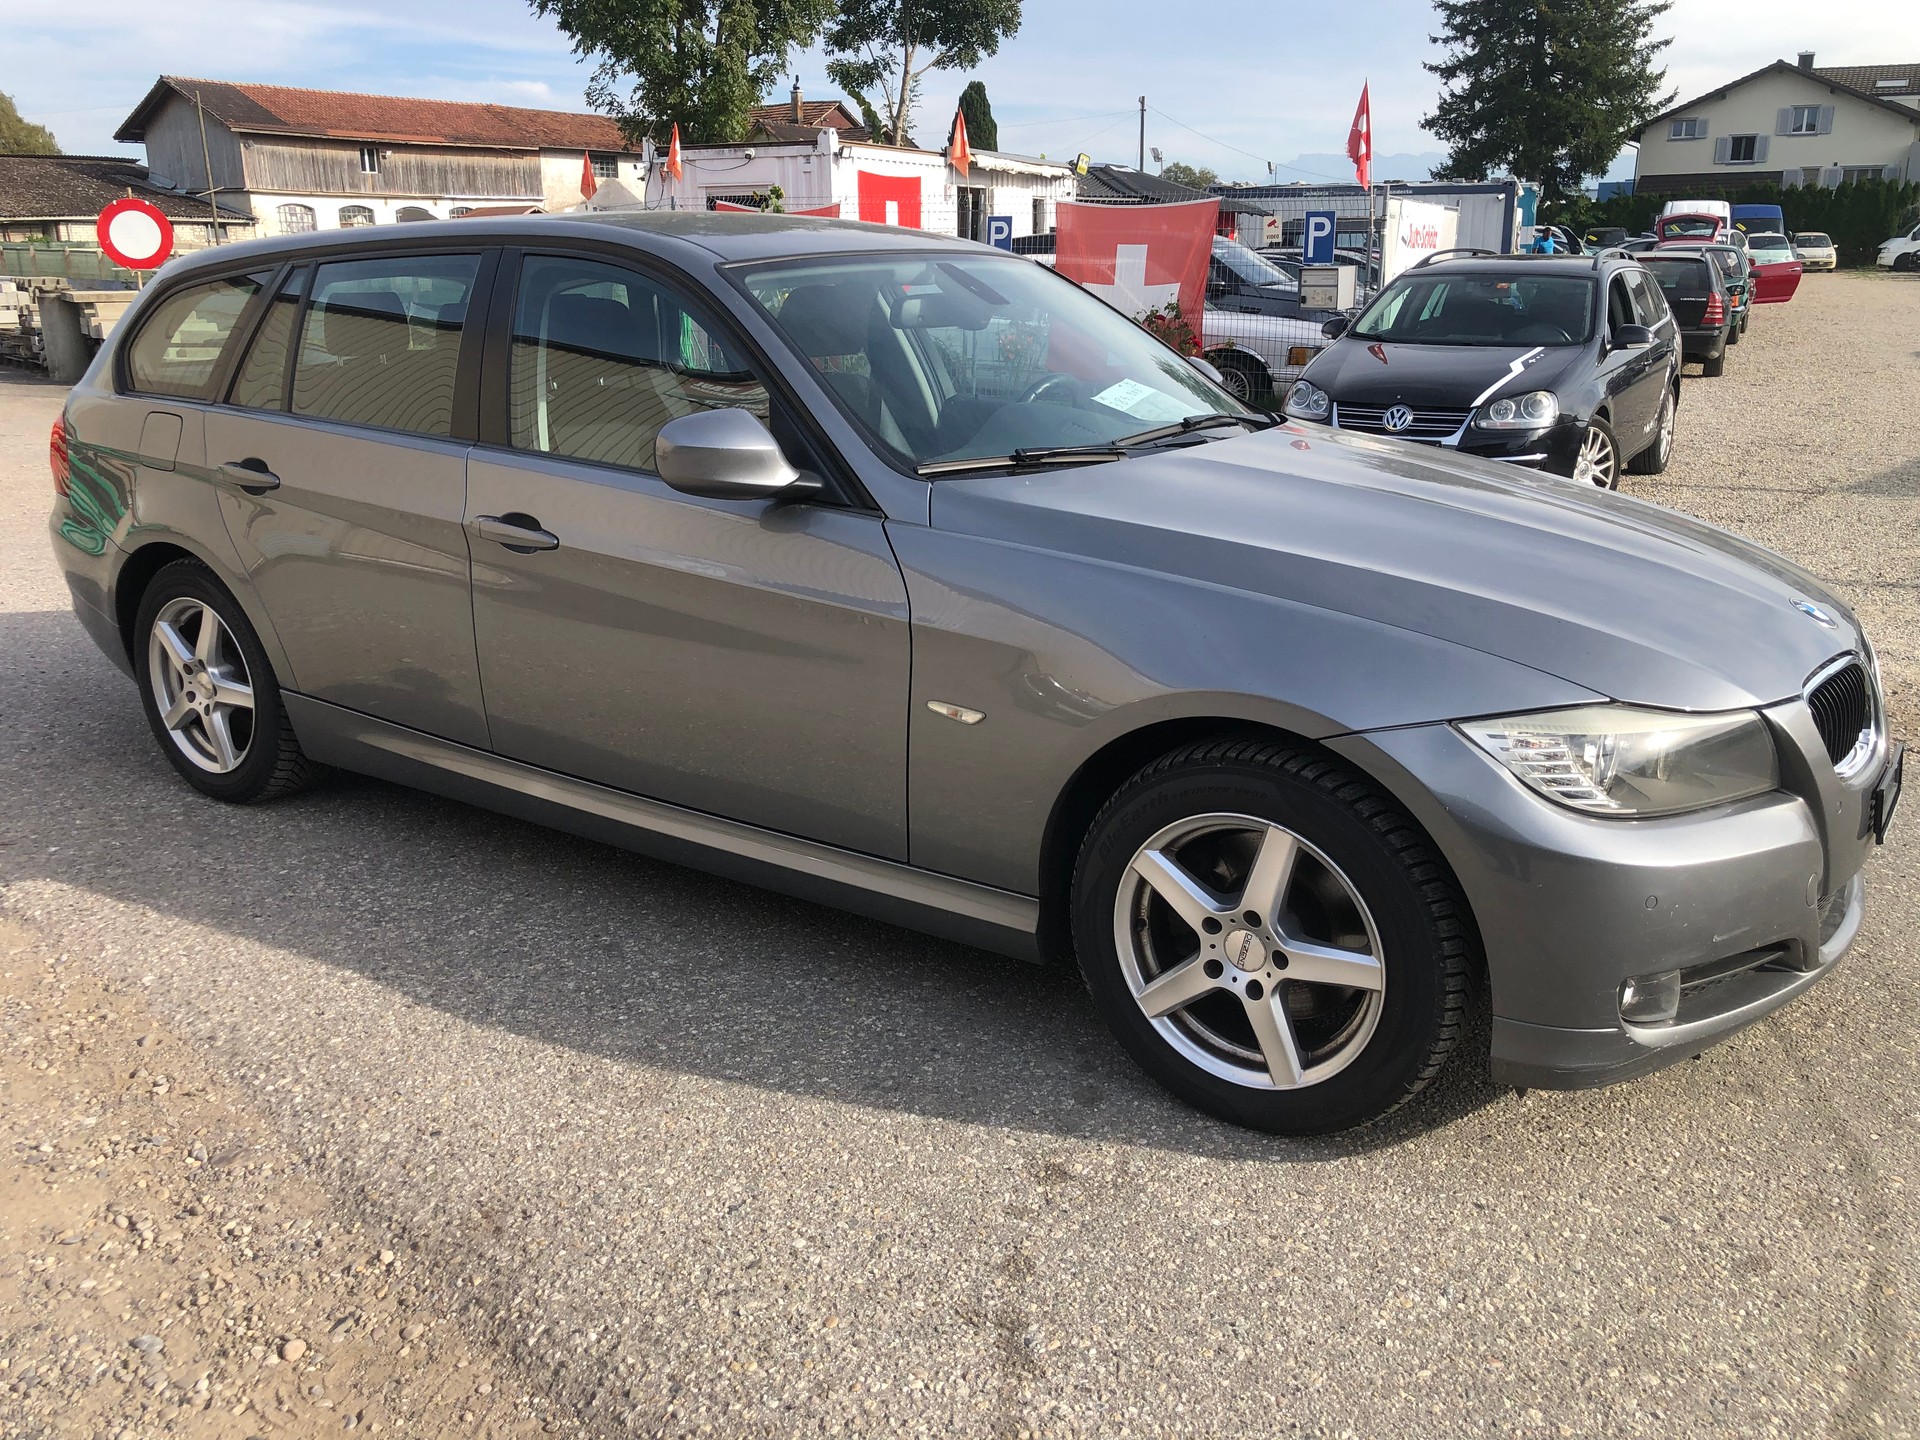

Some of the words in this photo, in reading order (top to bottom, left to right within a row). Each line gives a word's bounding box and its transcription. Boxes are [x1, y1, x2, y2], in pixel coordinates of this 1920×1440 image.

[990, 221, 1009, 247] P
[1308, 216, 1332, 258] P
[1238, 933, 1253, 968] DEZENT
